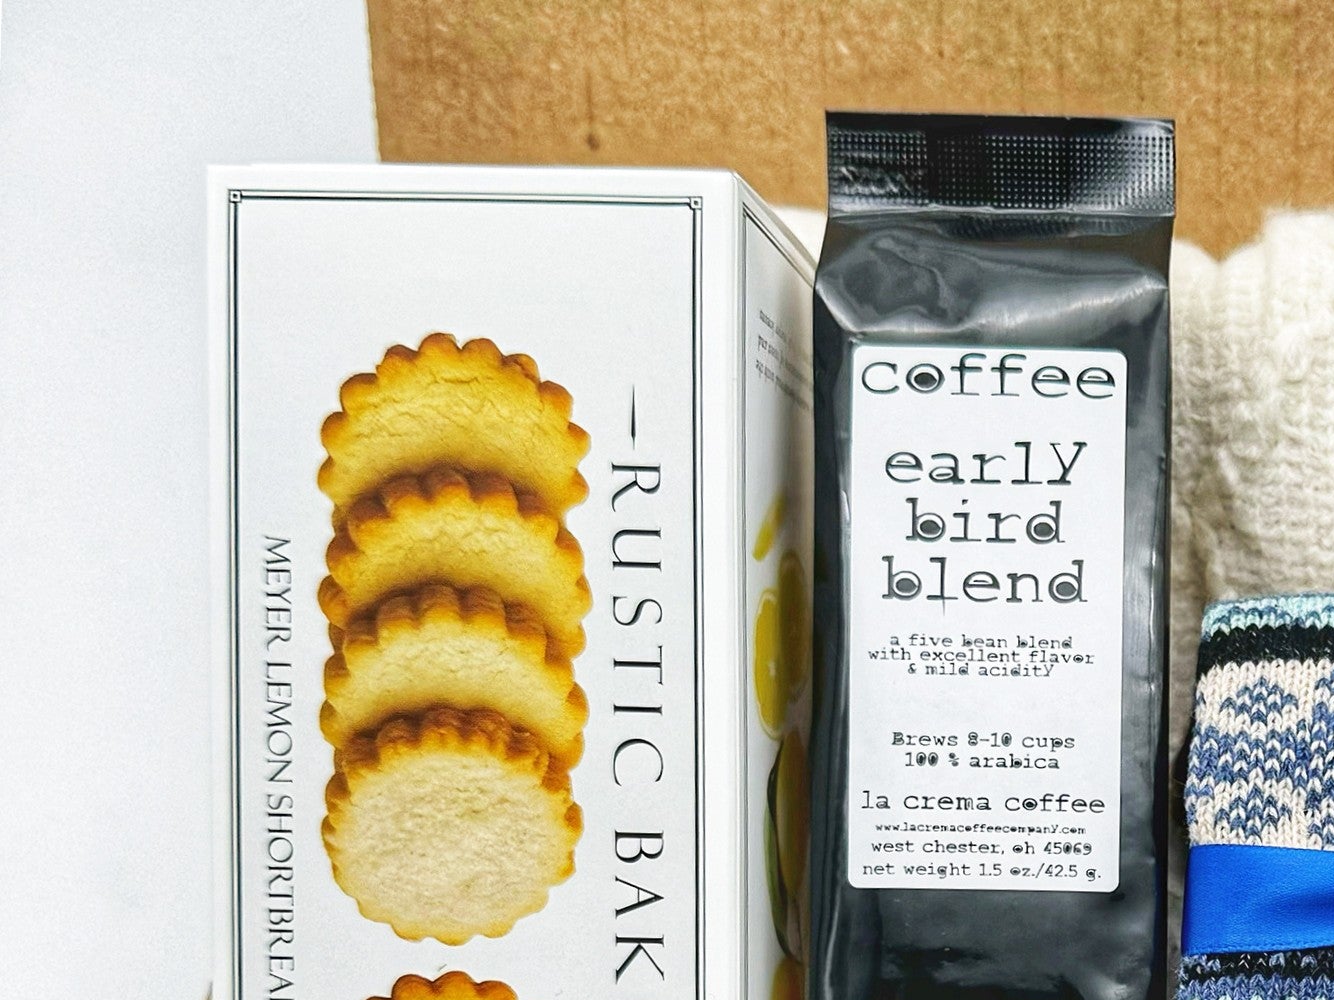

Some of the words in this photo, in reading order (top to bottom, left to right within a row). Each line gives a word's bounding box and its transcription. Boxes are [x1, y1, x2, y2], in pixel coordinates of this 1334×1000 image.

[862, 354, 1115, 399] coffee
[885, 442, 1087, 484] early
[906, 498, 1065, 543] bird
[882, 556, 1087, 604] blend
[264, 536, 292, 651] MEYER
[610, 462, 664, 787] RUSTIC
[890, 636, 900, 646] a
[909, 634, 952, 646] five
[962, 635, 1007, 648] bean
[1017, 635, 1072, 649] blend
[868, 649, 911, 660] with
[920, 650, 1020, 662] excellent
[1029, 650, 1095, 664] flavor
[908, 664, 917, 674] &
[925, 663, 969, 675] mild
[978, 664, 1054, 677] acidity
[265, 661, 293, 783] LEMON
[892, 732, 958, 746] Brews
[968, 732, 1012, 747] 8-10
[1022, 736, 1075, 751] cups
[905, 753, 938, 766] 100
[949, 753, 959, 766] %
[969, 754, 1060, 769] arabica
[862, 791, 890, 809] la
[904, 795, 992, 810] crema
[1005, 794, 1105, 813] coffee
[875, 822, 1086, 835] www.lacremacoffeecompany.com
[871, 841, 914, 853] west
[923, 841, 1005, 855] chester,
[1012, 842, 1035, 854] oh
[1044, 842, 1092, 855] 45069
[863, 864, 894, 875] net
[904, 863, 971, 879] weight
[979, 864, 1002, 876] 1.5
[1010, 863, 1078, 878] oz./42.5
[1086, 869, 1101, 881] g.
